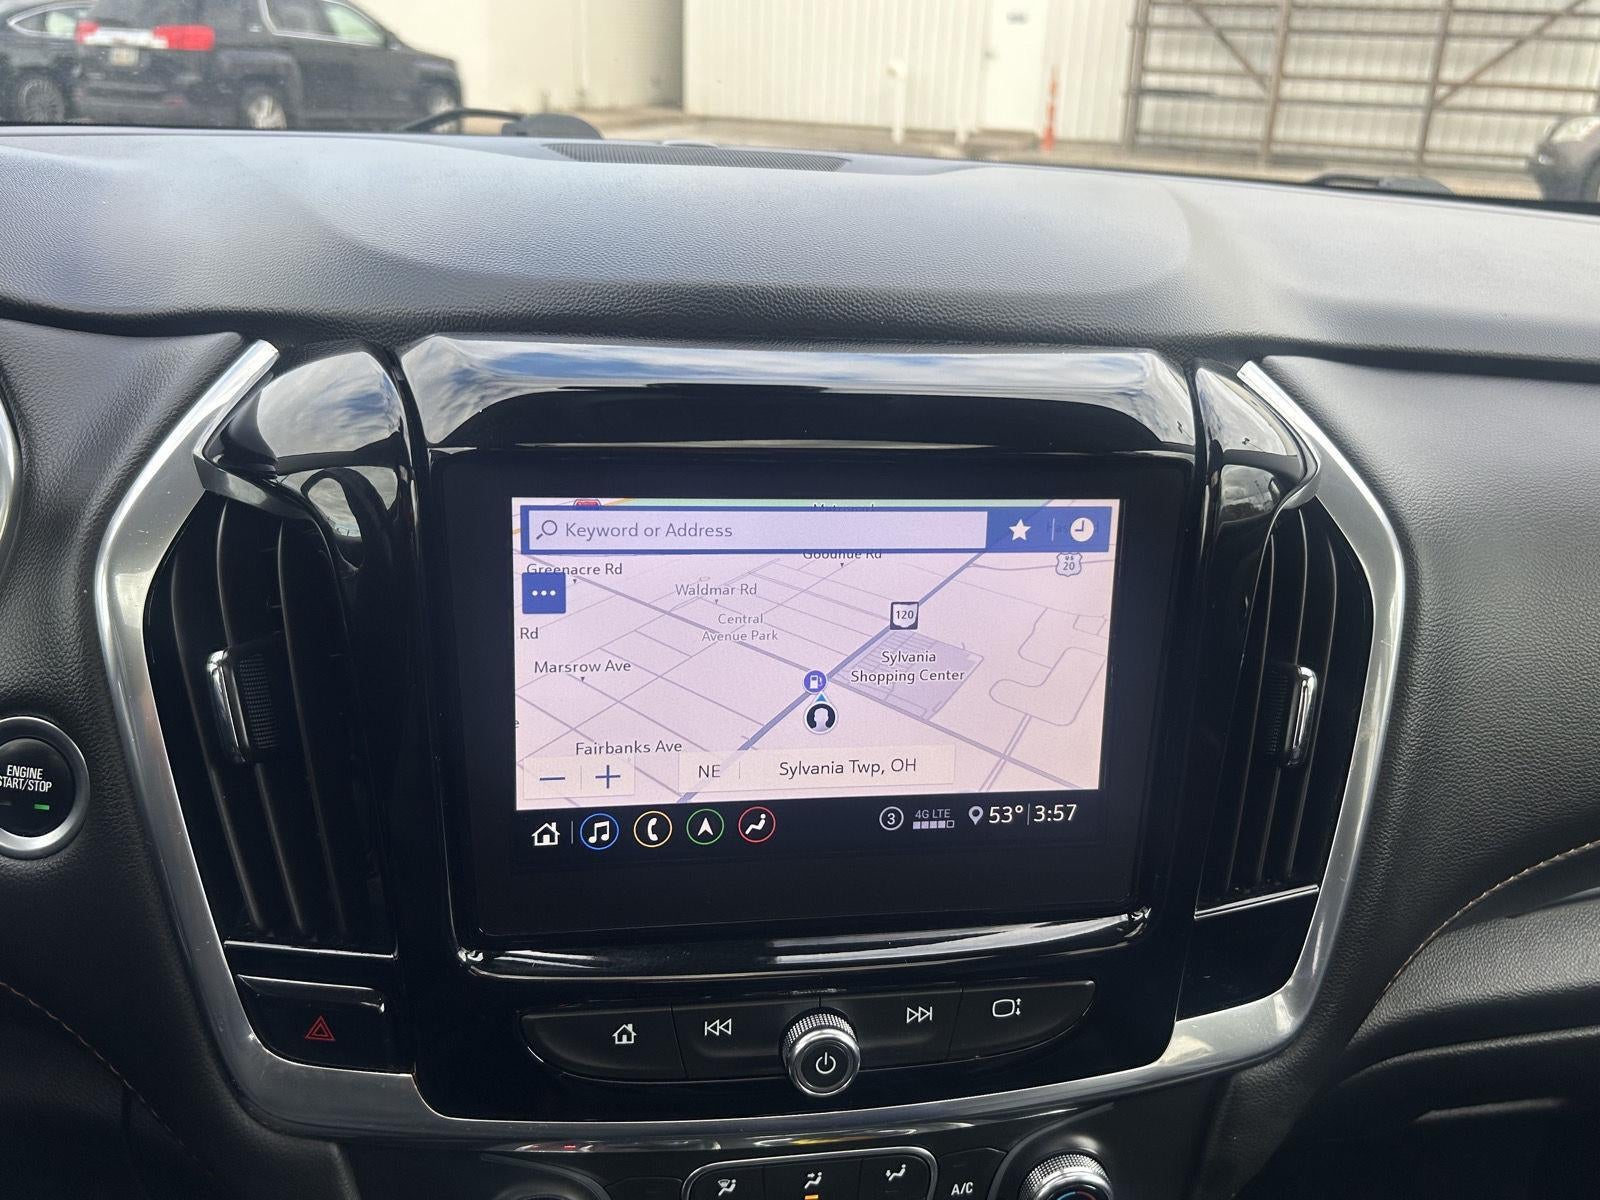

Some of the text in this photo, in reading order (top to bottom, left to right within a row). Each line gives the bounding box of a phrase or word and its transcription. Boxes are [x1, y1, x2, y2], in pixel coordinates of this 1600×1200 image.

[565, 522, 733, 541] Keyword or Address
[526, 562, 623, 575] Greenacre Rd
[1062, 561, 1076, 571] 20
[675, 583, 757, 596] Waldmar Rd
[717, 613, 764, 625] Central
[895, 609, 914, 620] 120
[520, 627, 539, 640] Rd
[702, 629, 778, 642] Avenue Park
[881, 650, 936, 666] Sylvania
[534, 659, 631, 674] Marsrow Ave
[850, 669, 965, 686] Shopping Center
[576, 740, 682, 756] Fairbanks Ave
[6, 764, 44, 780] ENGINE
[698, 758, 917, 780] NE Sylvania Twp, OH
[886, 803, 1078, 825] 3 4G LTE 53° 3:57
[950, 1181, 974, 1196] A/C
